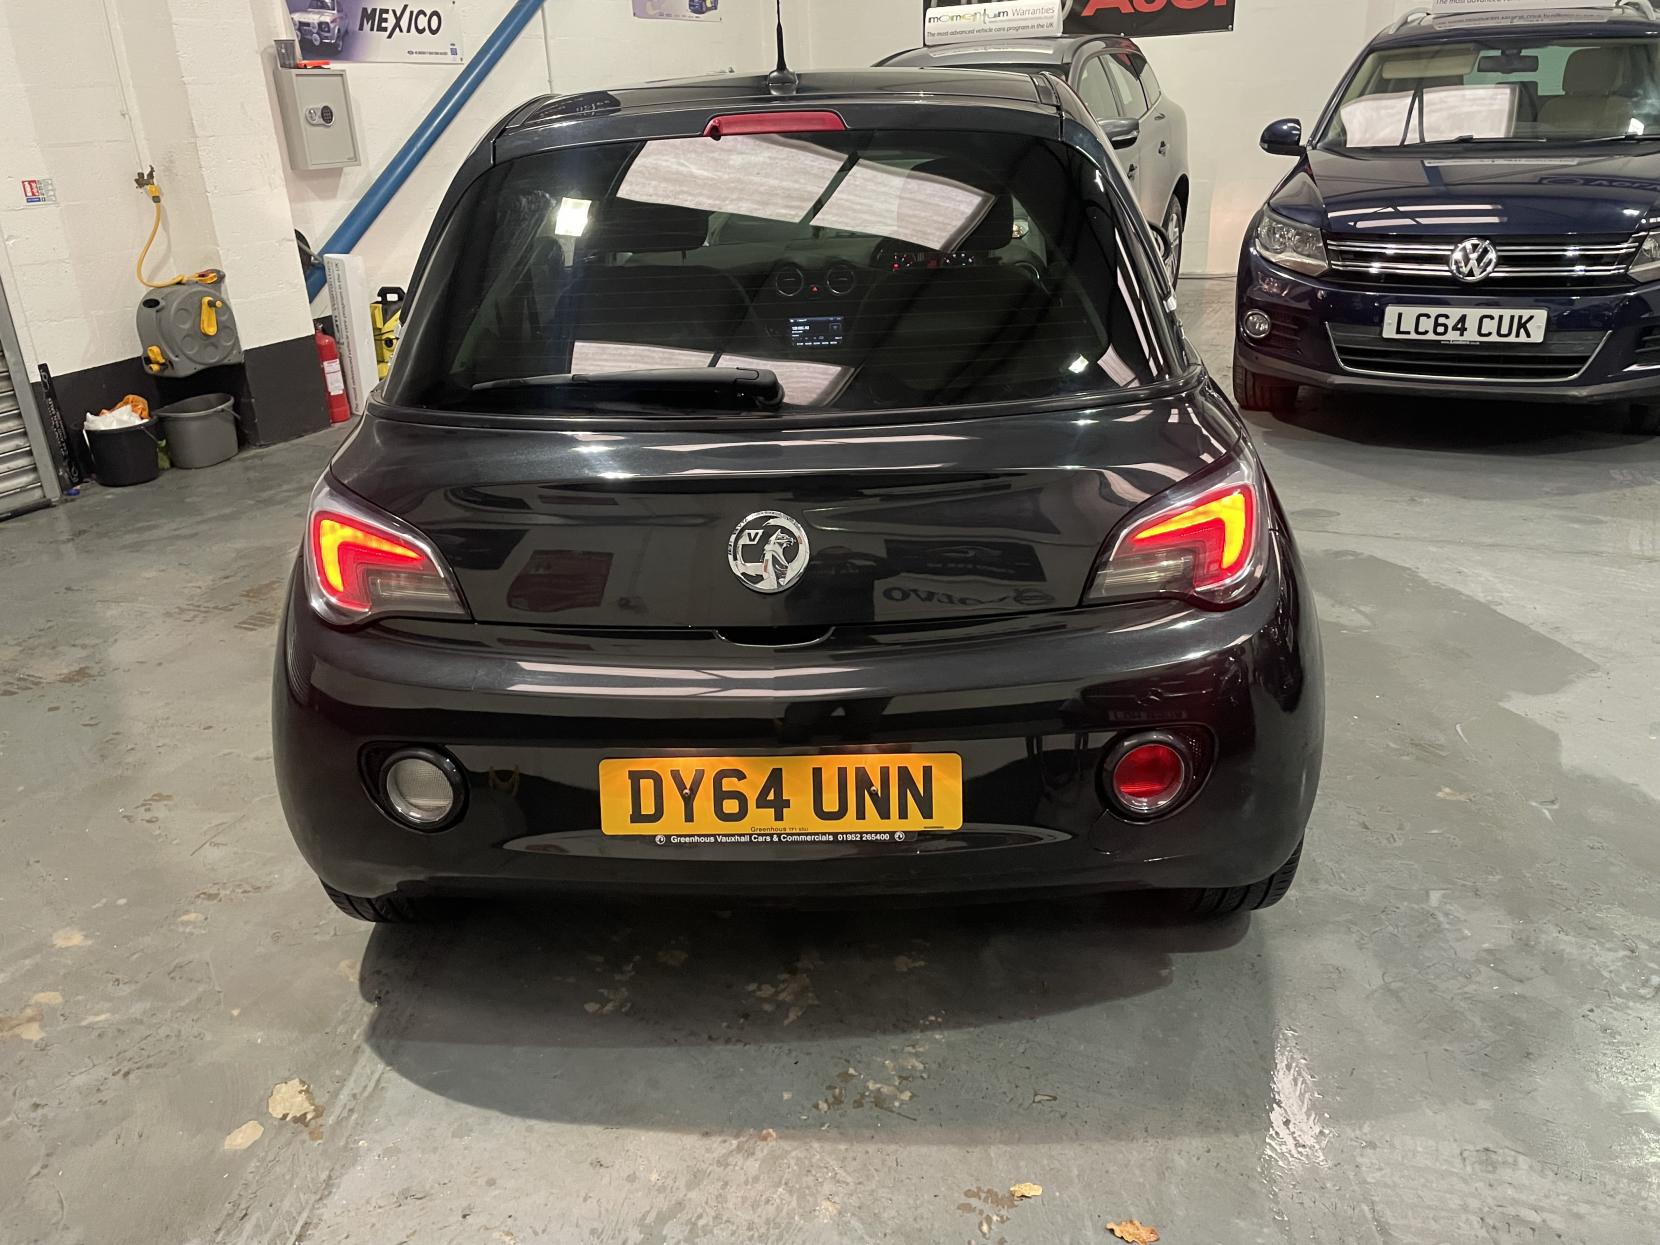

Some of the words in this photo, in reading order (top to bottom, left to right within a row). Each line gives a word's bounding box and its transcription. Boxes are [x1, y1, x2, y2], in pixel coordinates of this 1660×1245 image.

[358, 4, 442, 39] MEXICO
[928, 8, 1009, 25] momentum
[1011, 6, 1055, 17] Warranties
[949, 28, 975, 36] advanced
[976, 26, 993, 34] vehicle
[1006, 25, 1030, 33] program
[1395, 312, 1468, 337] LC64
[1477, 314, 1534, 338] CUK
[747, 532, 760, 542] V
[627, 767, 790, 824] DY64
[811, 765, 934, 821] UNN
[670, 835, 715, 843] Greenhous
[717, 834, 750, 843] Vauxhall
[752, 834, 771, 842] Cars
[772, 834, 779, 842] &
[780, 833, 834, 842] Commercials
[837, 833, 860, 841] 01952
[862, 833, 890, 841] 265400
